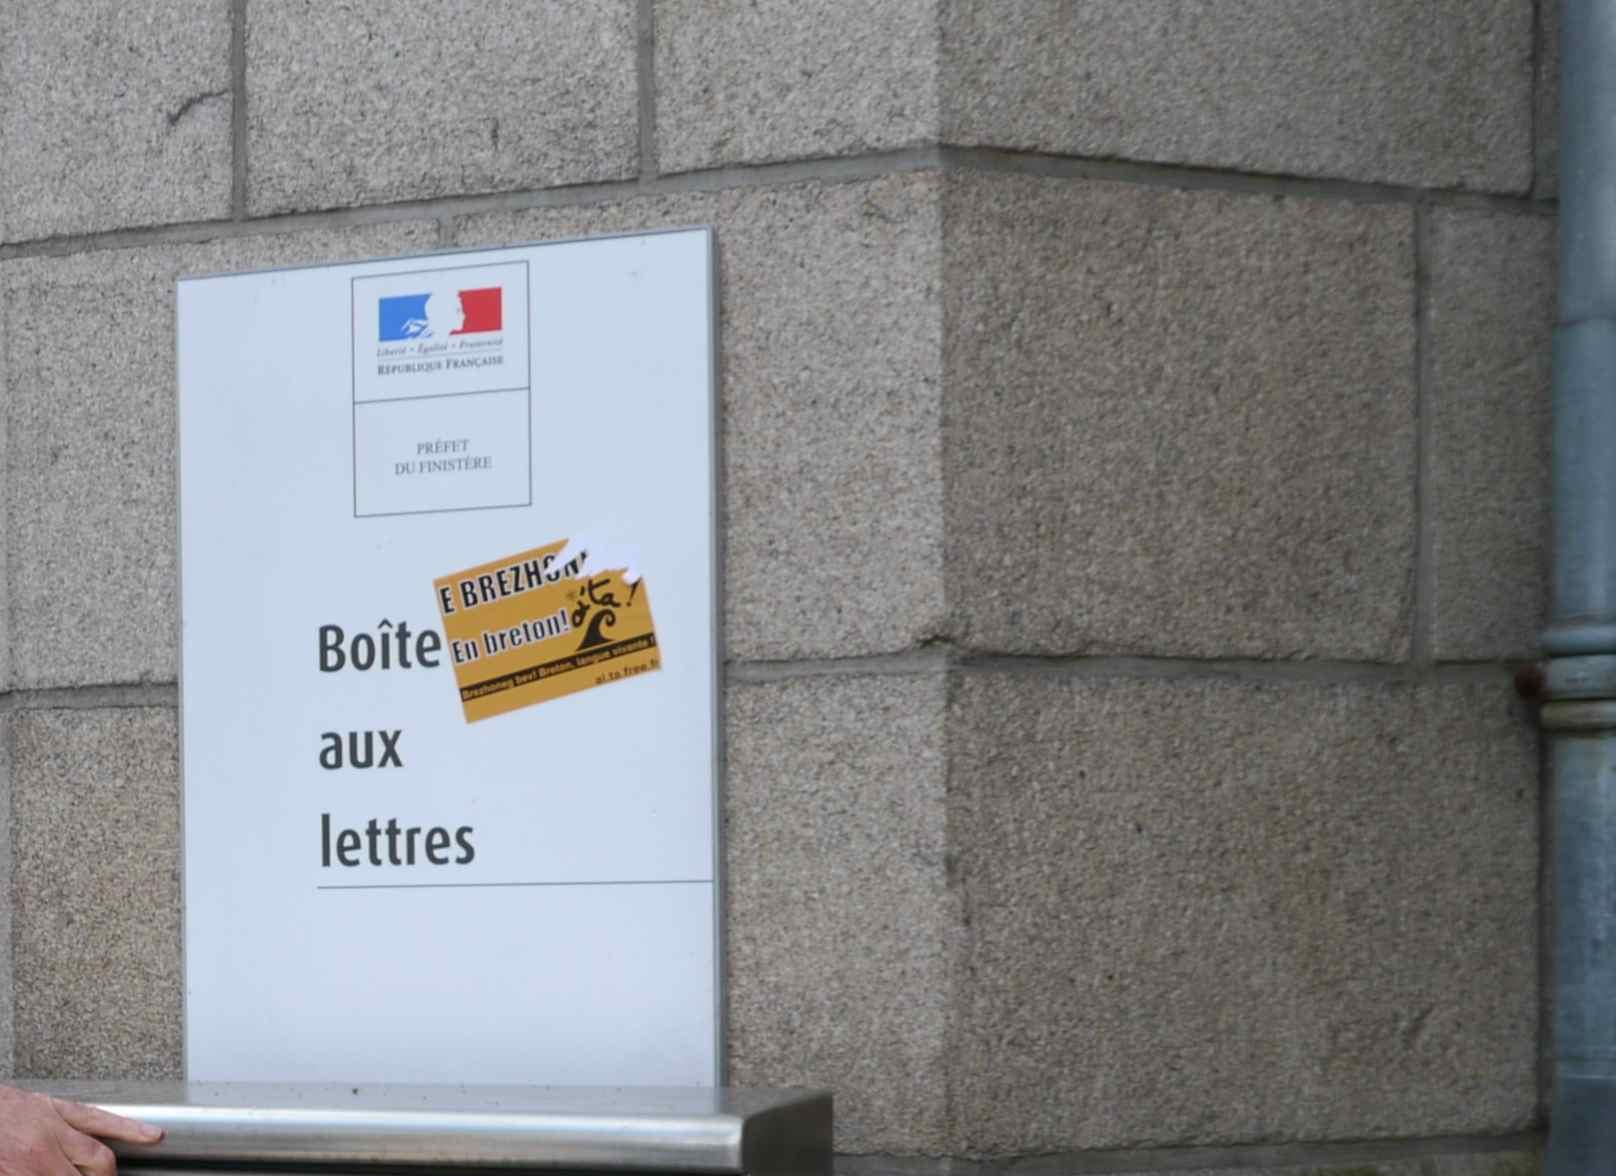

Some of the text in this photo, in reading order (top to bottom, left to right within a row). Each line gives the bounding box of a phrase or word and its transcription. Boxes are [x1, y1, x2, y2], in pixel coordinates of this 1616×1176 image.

[394, 461, 416, 476] DU
[416, 437, 470, 455] PRÉFET
[318, 618, 442, 673] Boîte
[452, 608, 570, 664] En breton!
[318, 728, 404, 771] aux
[320, 813, 476, 868] lettres
